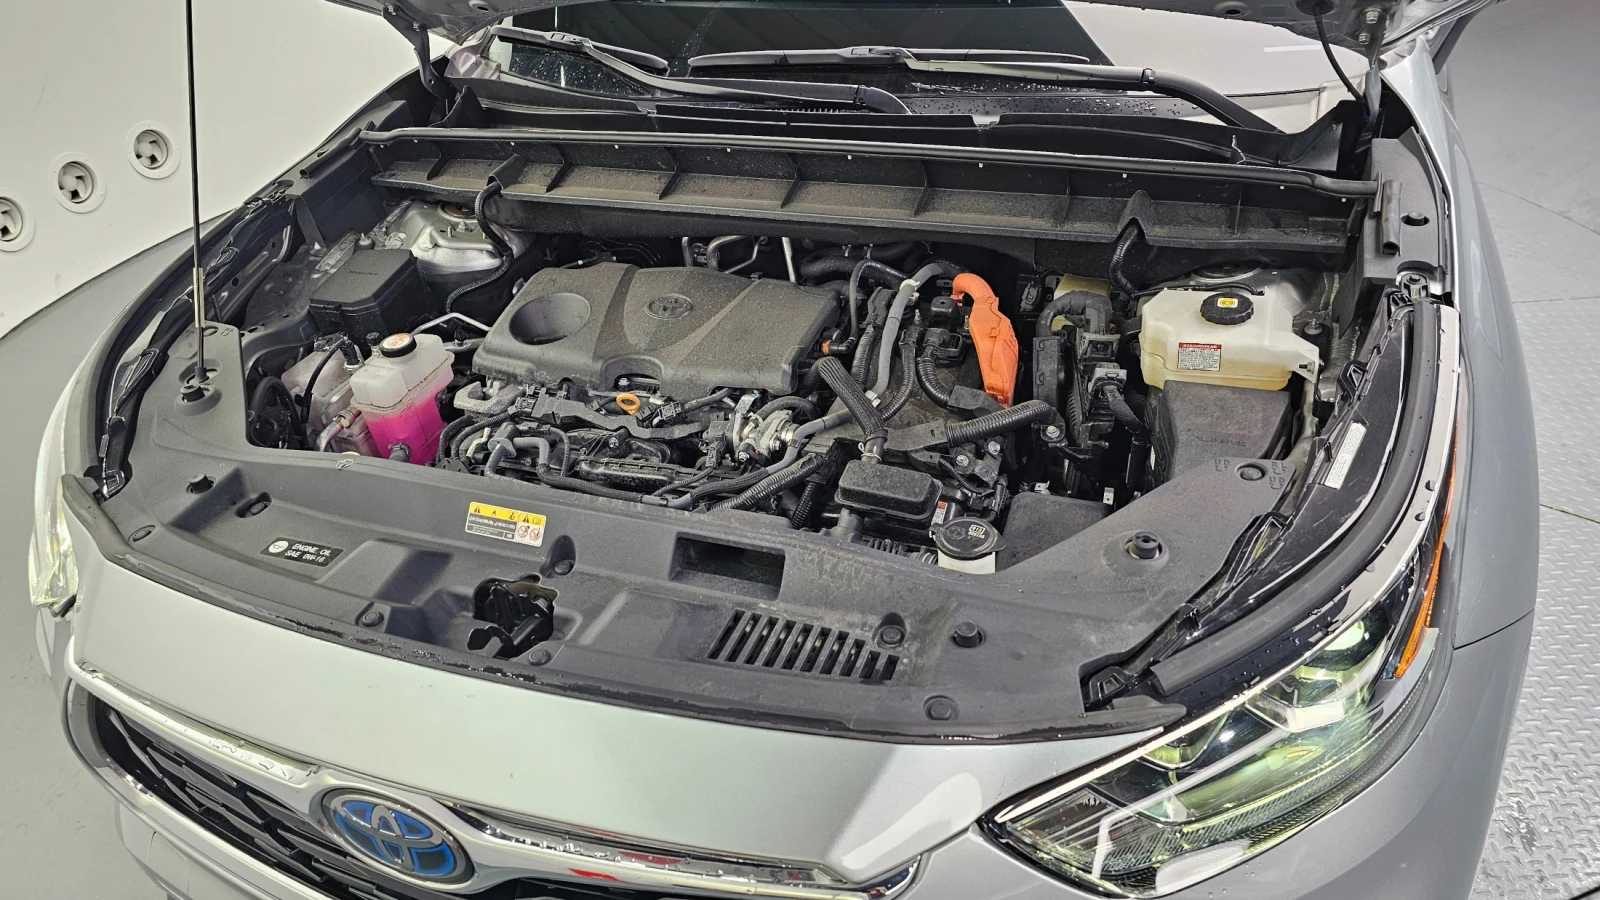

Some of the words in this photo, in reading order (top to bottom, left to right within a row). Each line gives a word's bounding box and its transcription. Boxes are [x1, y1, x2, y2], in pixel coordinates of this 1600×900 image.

[284, 549, 302, 558] SAE
[291, 543, 319, 554] ENGINE
[319, 549, 332, 557] OIL
